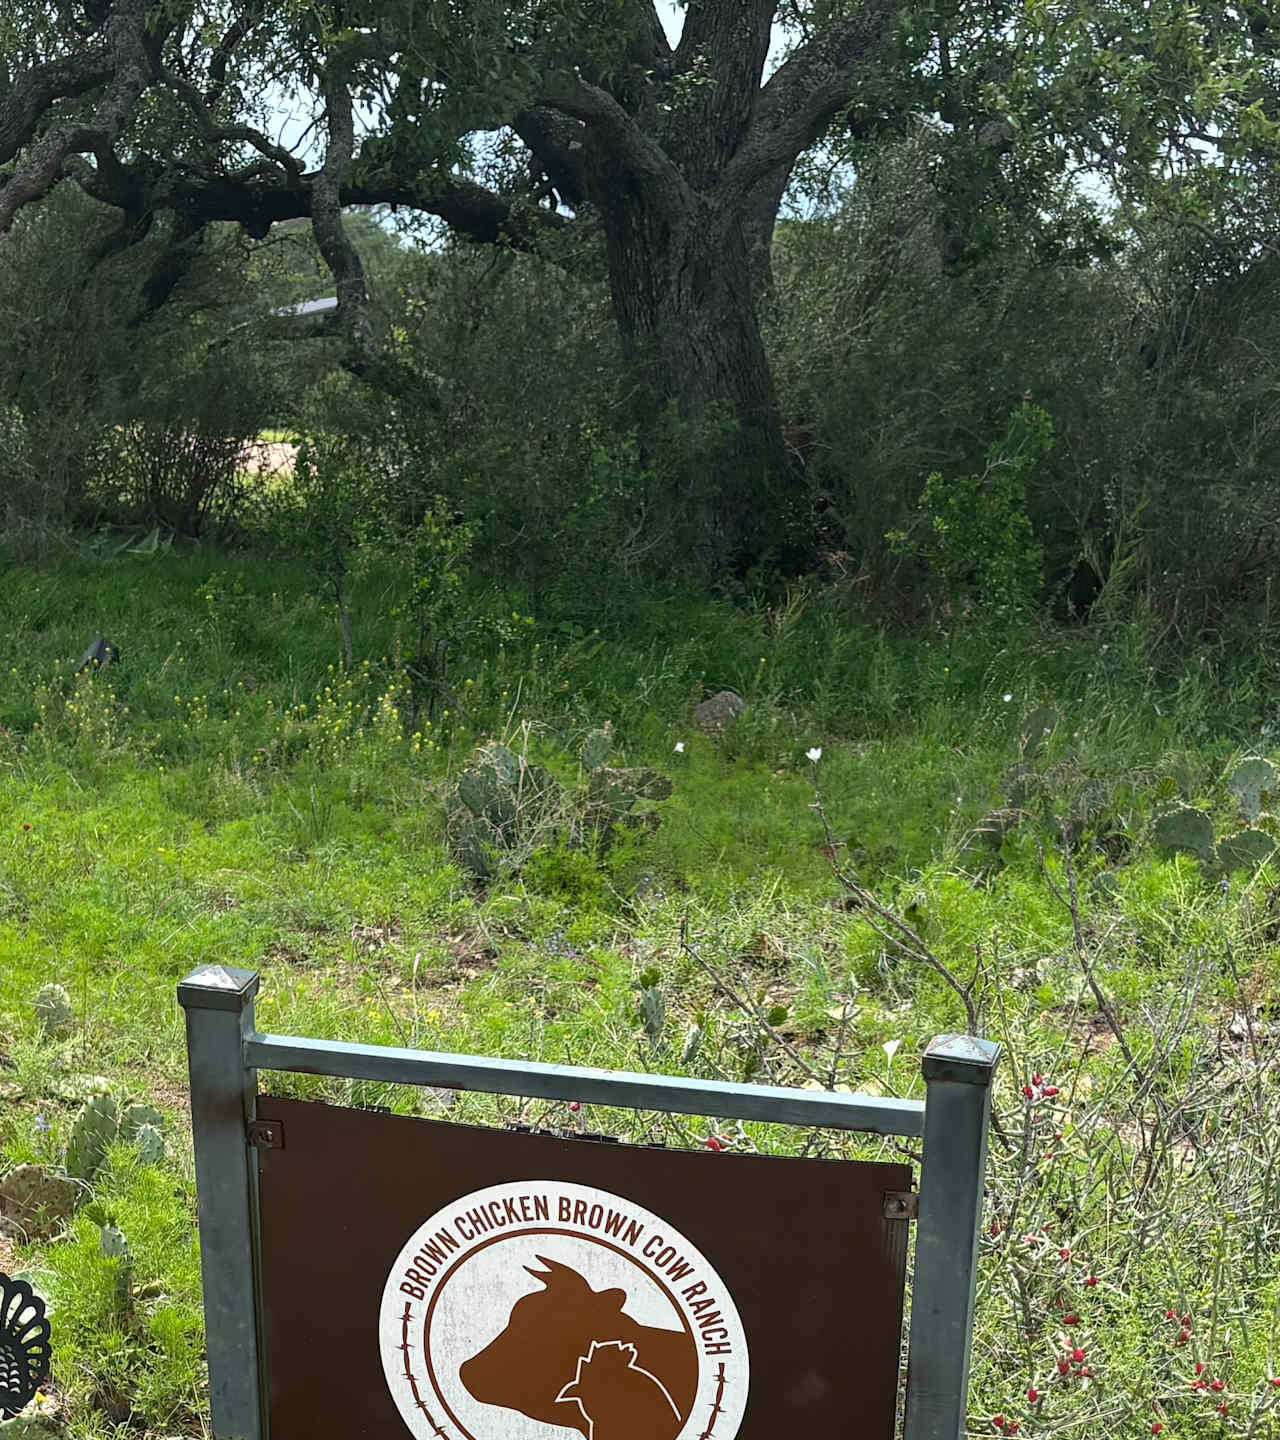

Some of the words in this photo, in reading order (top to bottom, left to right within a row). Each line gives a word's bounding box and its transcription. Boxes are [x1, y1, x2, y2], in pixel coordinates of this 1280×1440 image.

[399, 1226, 460, 1301] BROWN
[454, 1195, 550, 1241] CHICKEN
[558, 1197, 645, 1247] BROWN
[642, 1235, 695, 1283] COW
[681, 1280, 732, 1356] RANCH
